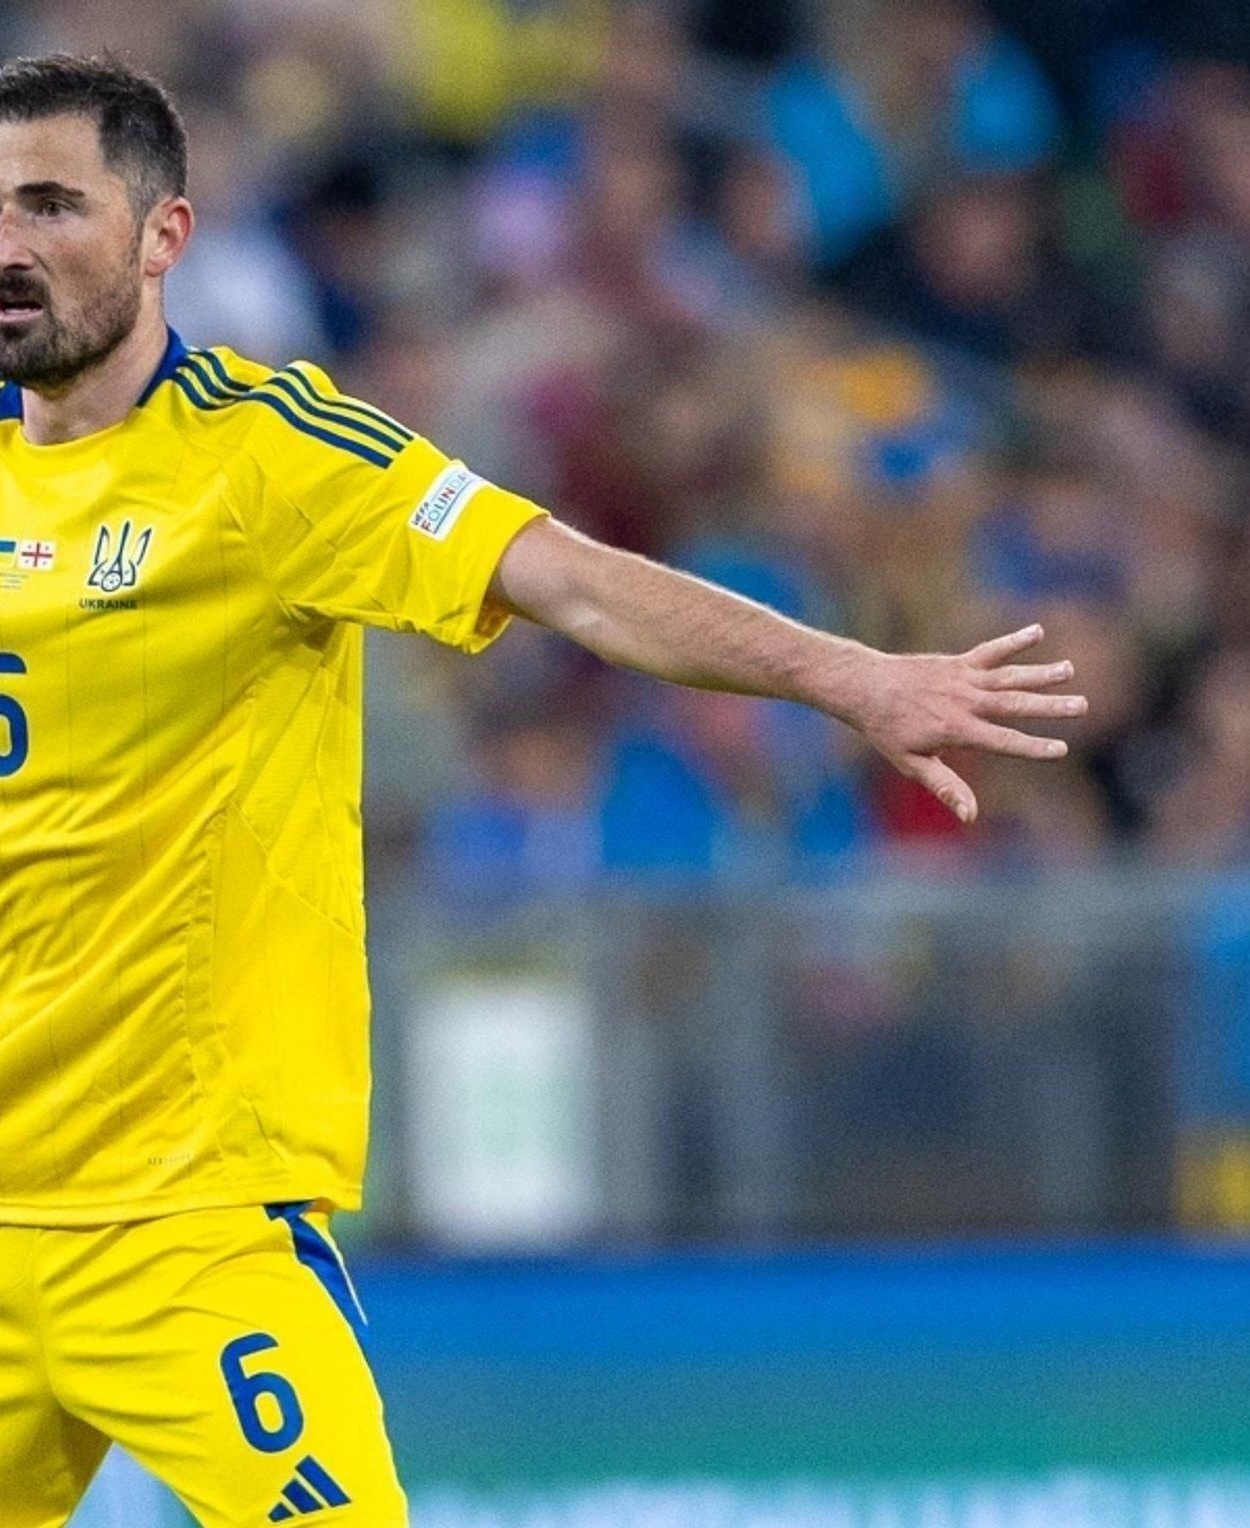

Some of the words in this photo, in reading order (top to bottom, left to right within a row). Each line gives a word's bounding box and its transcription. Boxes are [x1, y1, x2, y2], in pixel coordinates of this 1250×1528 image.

[421, 470, 467, 532] FOUNDA
[78, 598, 138, 611] UKRAINE
[218, 1331, 306, 1455] 6
